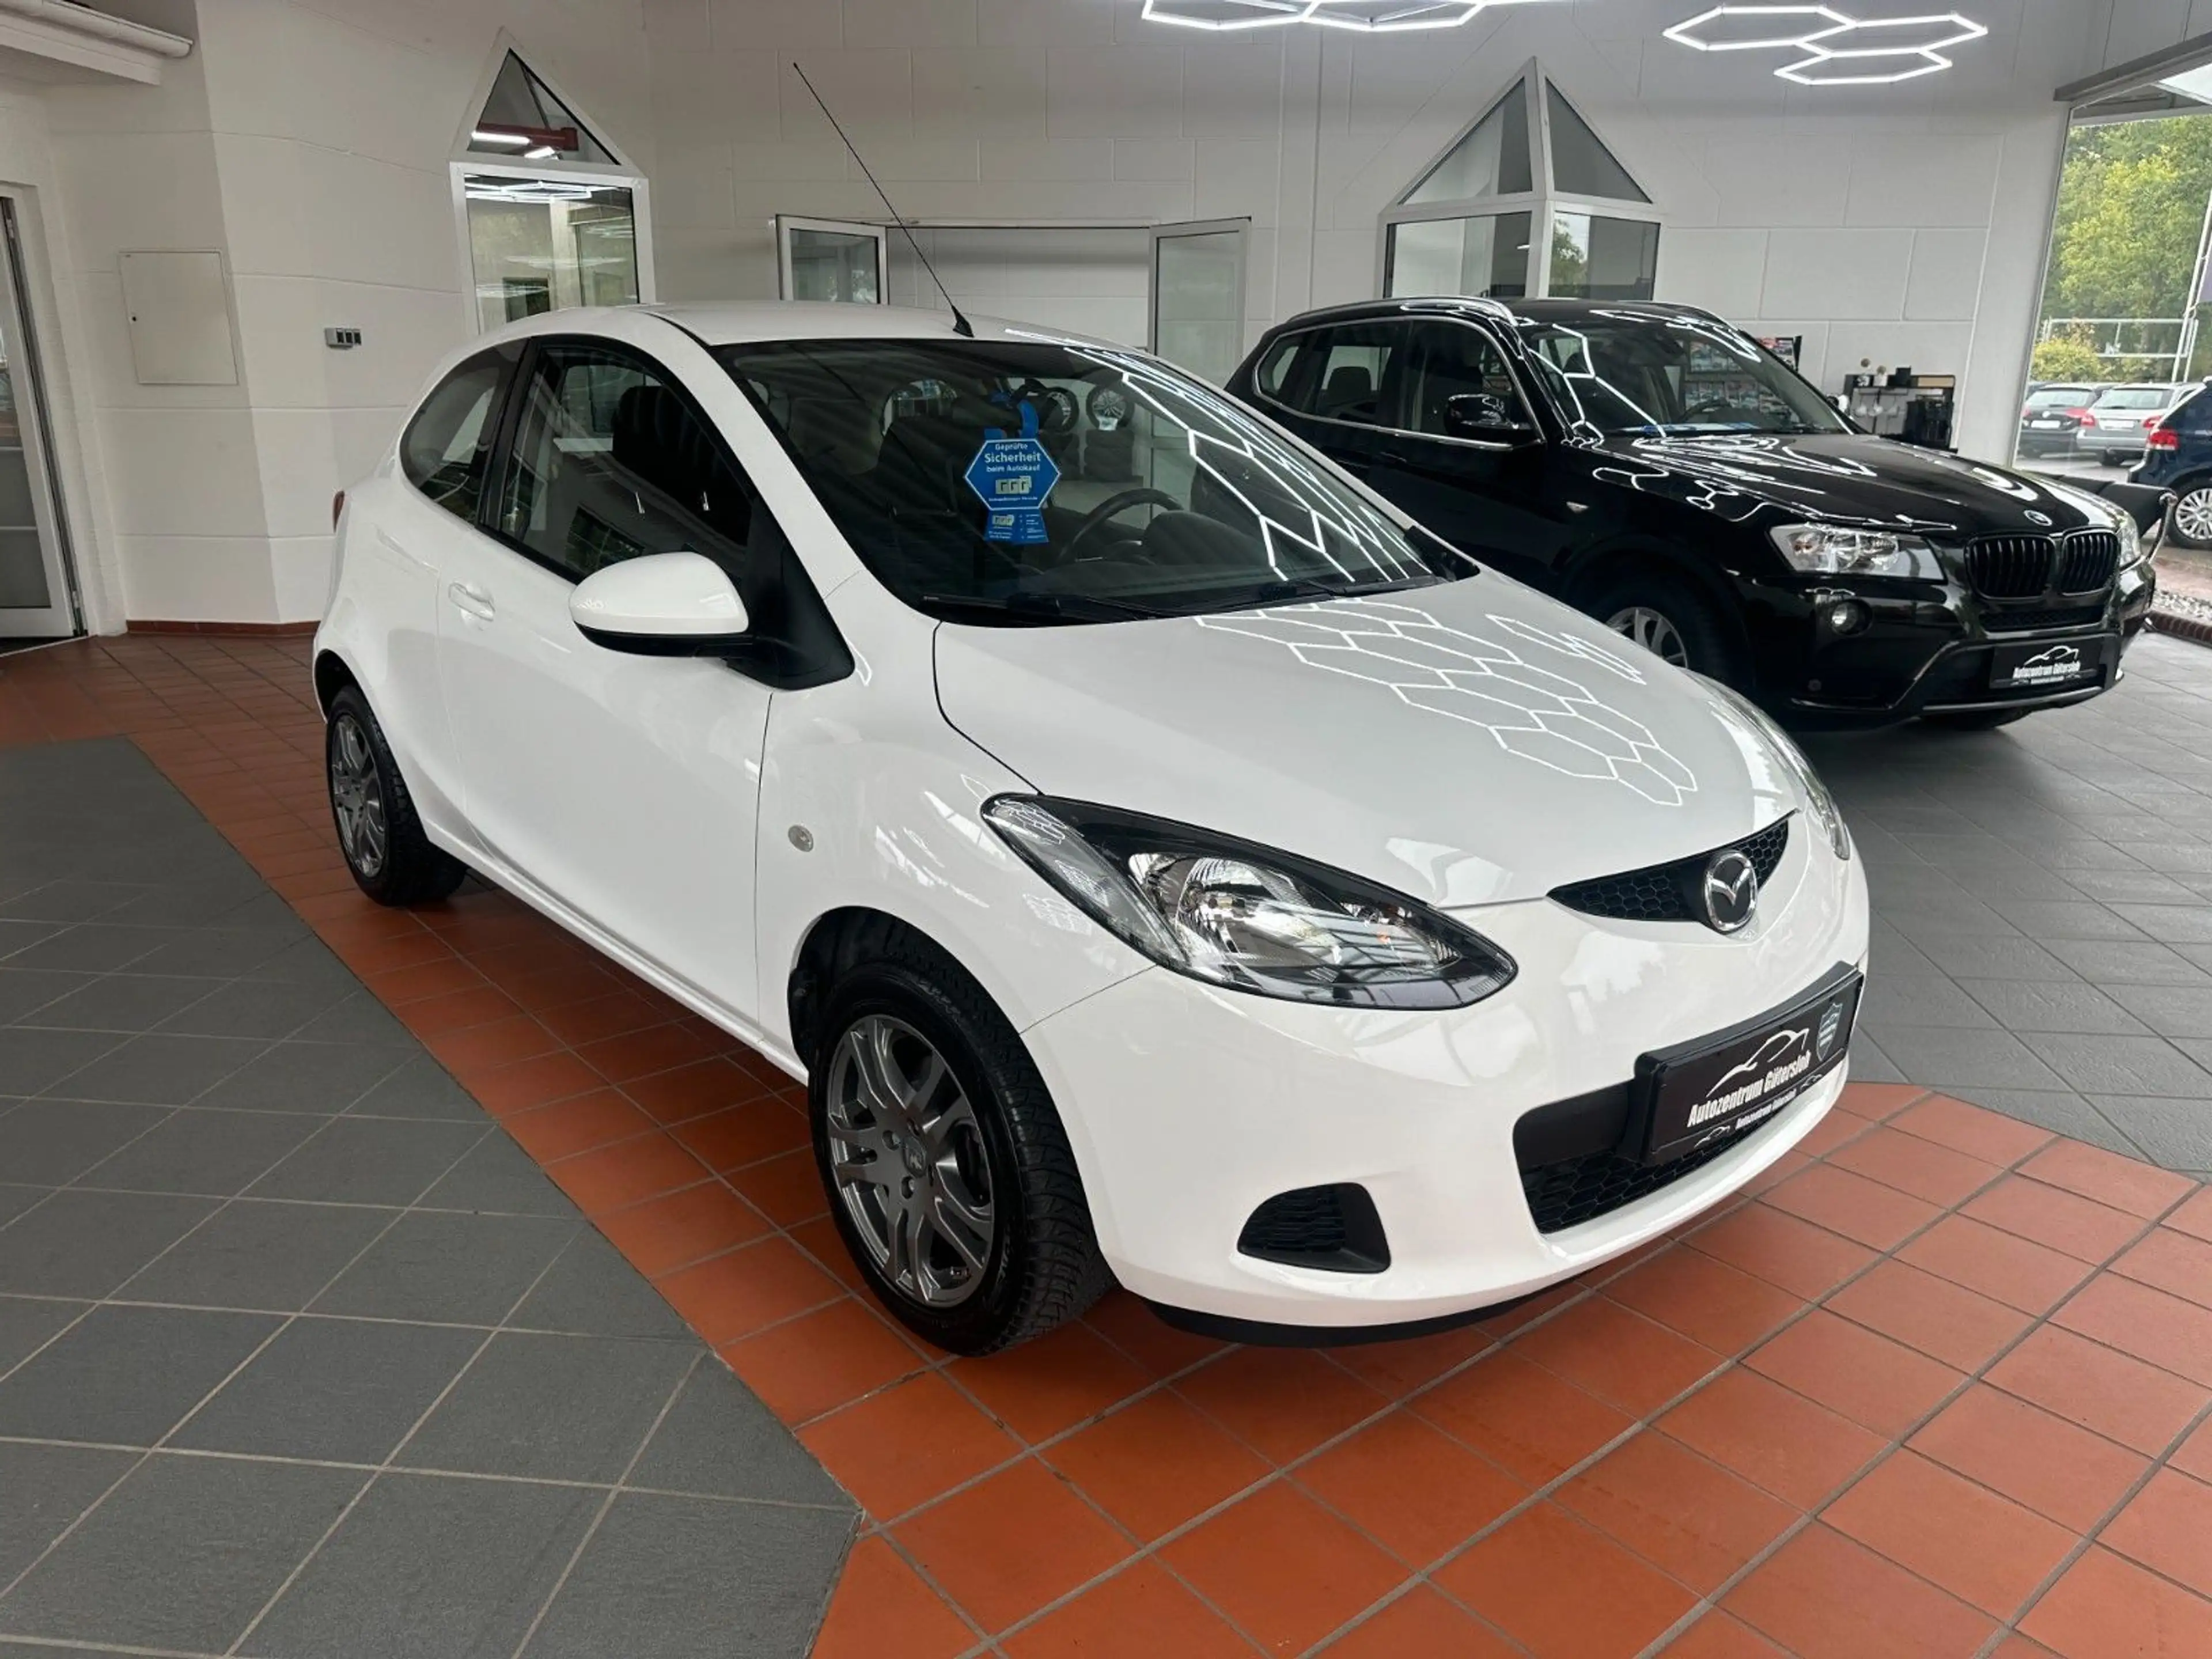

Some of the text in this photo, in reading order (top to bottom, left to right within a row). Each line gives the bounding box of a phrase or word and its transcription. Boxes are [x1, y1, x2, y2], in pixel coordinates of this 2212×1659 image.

[984, 452, 1041, 463] Sicherheit
[1687, 1050, 1811, 1127] Autozentrum Gütersloh
